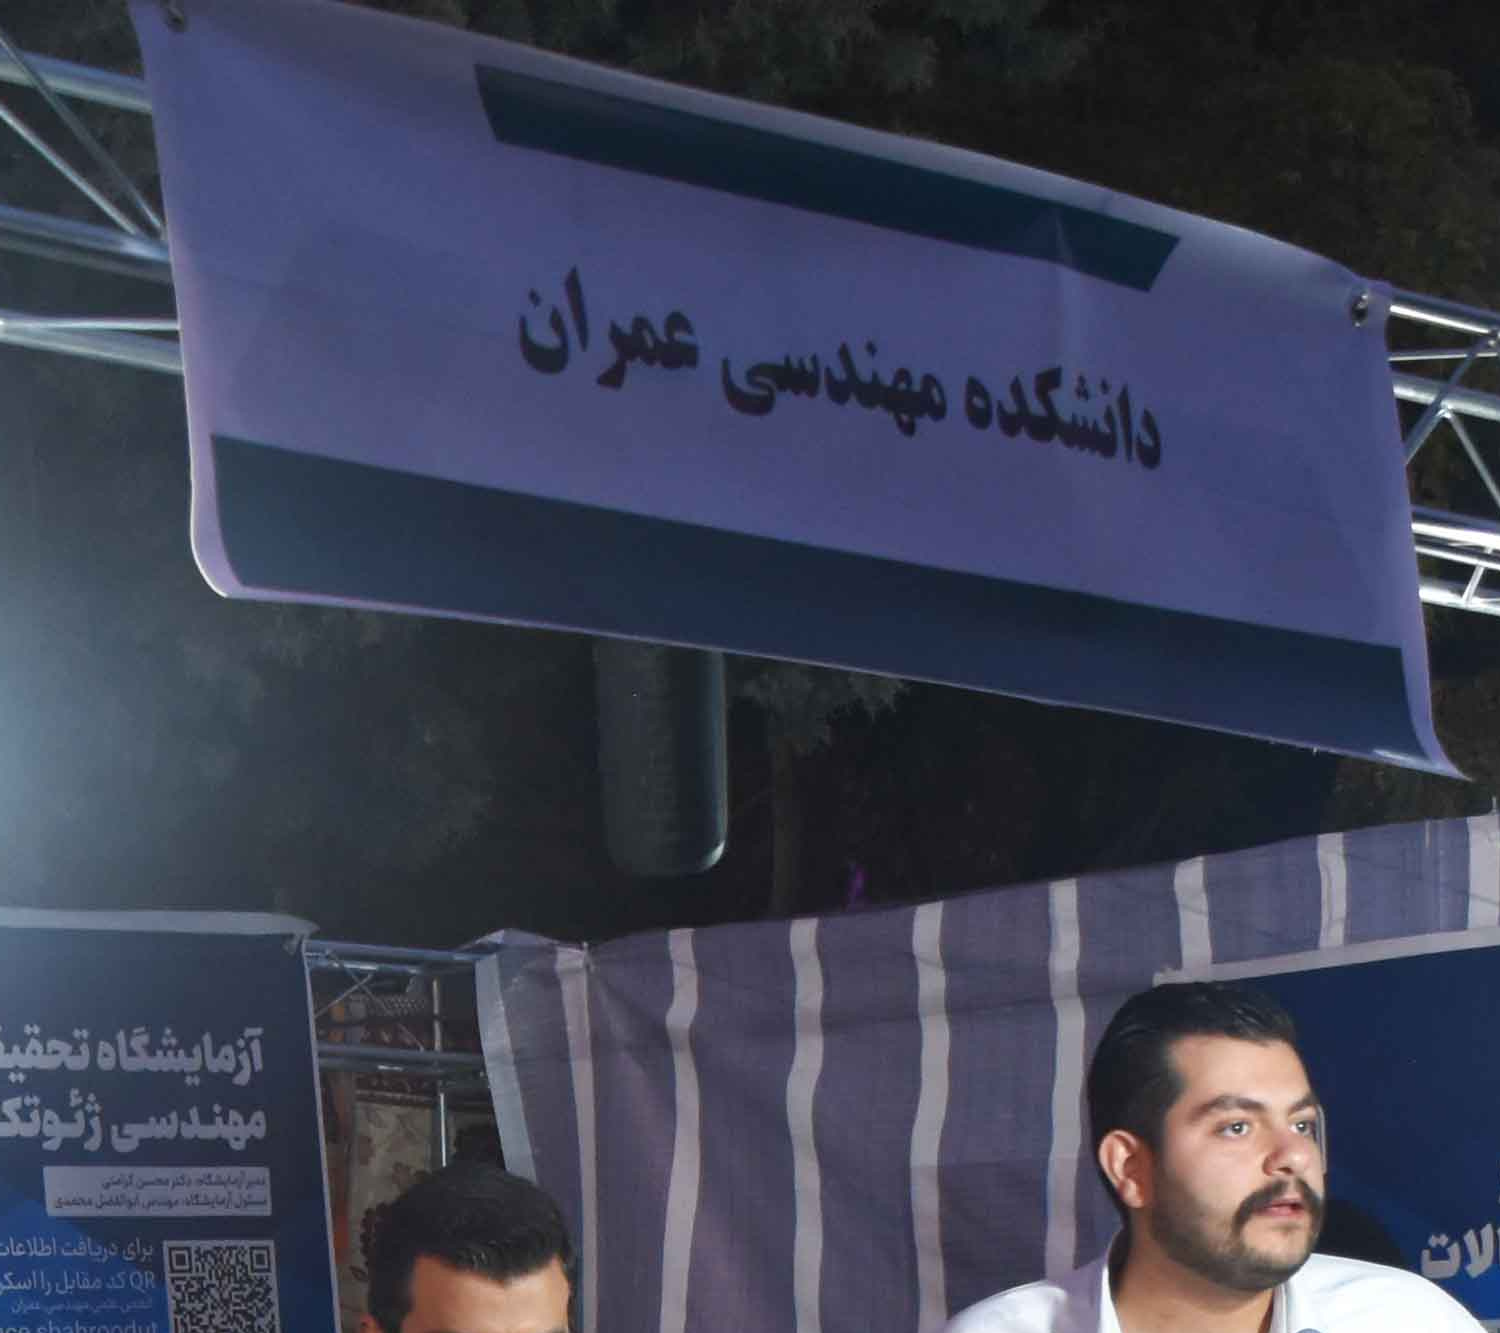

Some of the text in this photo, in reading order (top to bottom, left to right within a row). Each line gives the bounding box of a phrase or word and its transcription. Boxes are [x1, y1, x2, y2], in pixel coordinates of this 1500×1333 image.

[518, 265, 1162, 469] دانشکده مهندسی عمران
[96, 1024, 265, 1087] آزمایشگاه
[111, 1100, 268, 1153] مهندسی
[60, 1238, 118, 1263] دریافت
[121, 1236, 154, 1262] برای
[40, 1271, 52, 1296] را
[55, 1270, 102, 1295] مقابل
[105, 1270, 127, 1290] کد
[128, 1271, 157, 1292] QR
